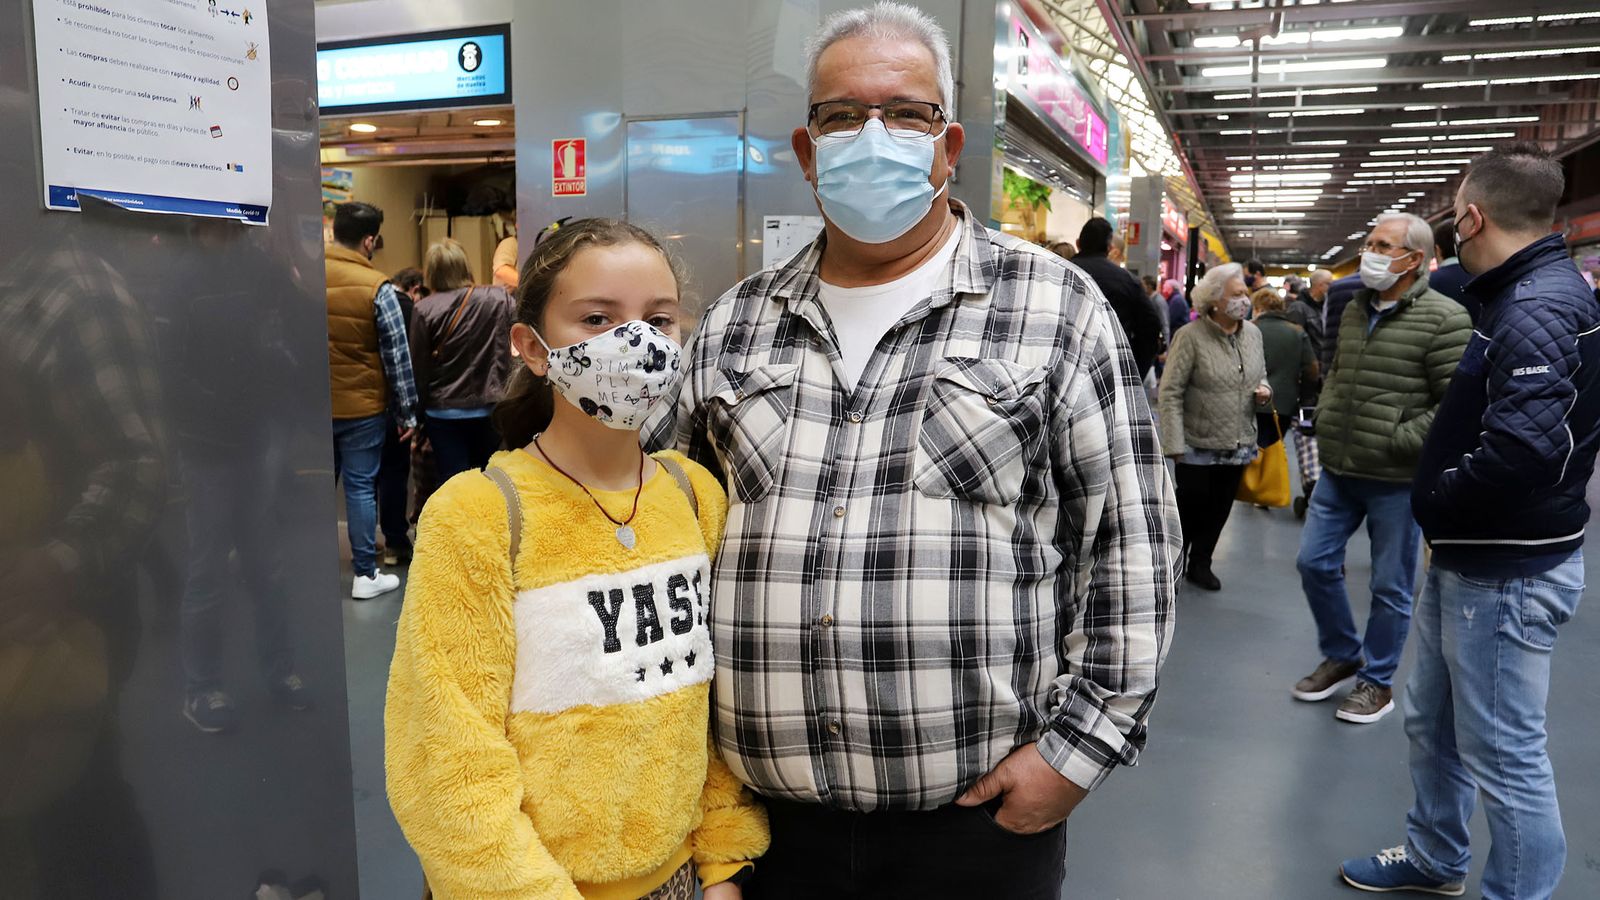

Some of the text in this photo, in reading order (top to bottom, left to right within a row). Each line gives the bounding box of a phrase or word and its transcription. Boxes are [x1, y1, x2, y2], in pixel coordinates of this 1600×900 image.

[78, 3, 111, 16] prohibido
[112, 11, 126, 20] para
[127, 14, 136, 22] los
[137, 17, 160, 27] clientes
[160, 22, 177, 31] tocar
[64, 17, 72, 25] Se
[74, 22, 112, 35] recomienda
[112, 30, 121, 38] no
[121, 32, 137, 41] tocar
[138, 35, 148, 43] las
[148, 39, 179, 51] superficies
[179, 45, 187, 53] de
[188, 46, 197, 54] los
[66, 47, 77, 57] Las
[78, 51, 108, 63] compras
[109, 59, 129, 67] deben
[129, 61, 158, 73] realizarse
[159, 68, 170, 76] con
[171, 70, 192, 81] rapidez
[68, 78, 91, 88] Acudir
[97, 84, 124, 94] comprar
[124, 88, 137, 96] una
[137, 91, 151, 99] sola
[71, 107, 91, 117] Tratar
[100, 113, 121, 122] evitar
[122, 115, 130, 123] las
[131, 118, 157, 129] compras
[166, 121, 178, 131] días
[183, 125, 199, 135] horas
[73, 118, 96, 129] mayor
[96, 121, 127, 133] afluencia
[73, 146, 97, 157] Evitar,
[113, 152, 137, 162] posible,
[143, 157, 159, 166] pago
[170, 160, 190, 169] dinero
[554, 181, 585, 193] EXTINTOR
[596, 357, 629, 374] SIM
[1526, 365, 1550, 375] BASIC
[596, 374, 630, 389] PLY
[598, 391, 619, 405] ME
